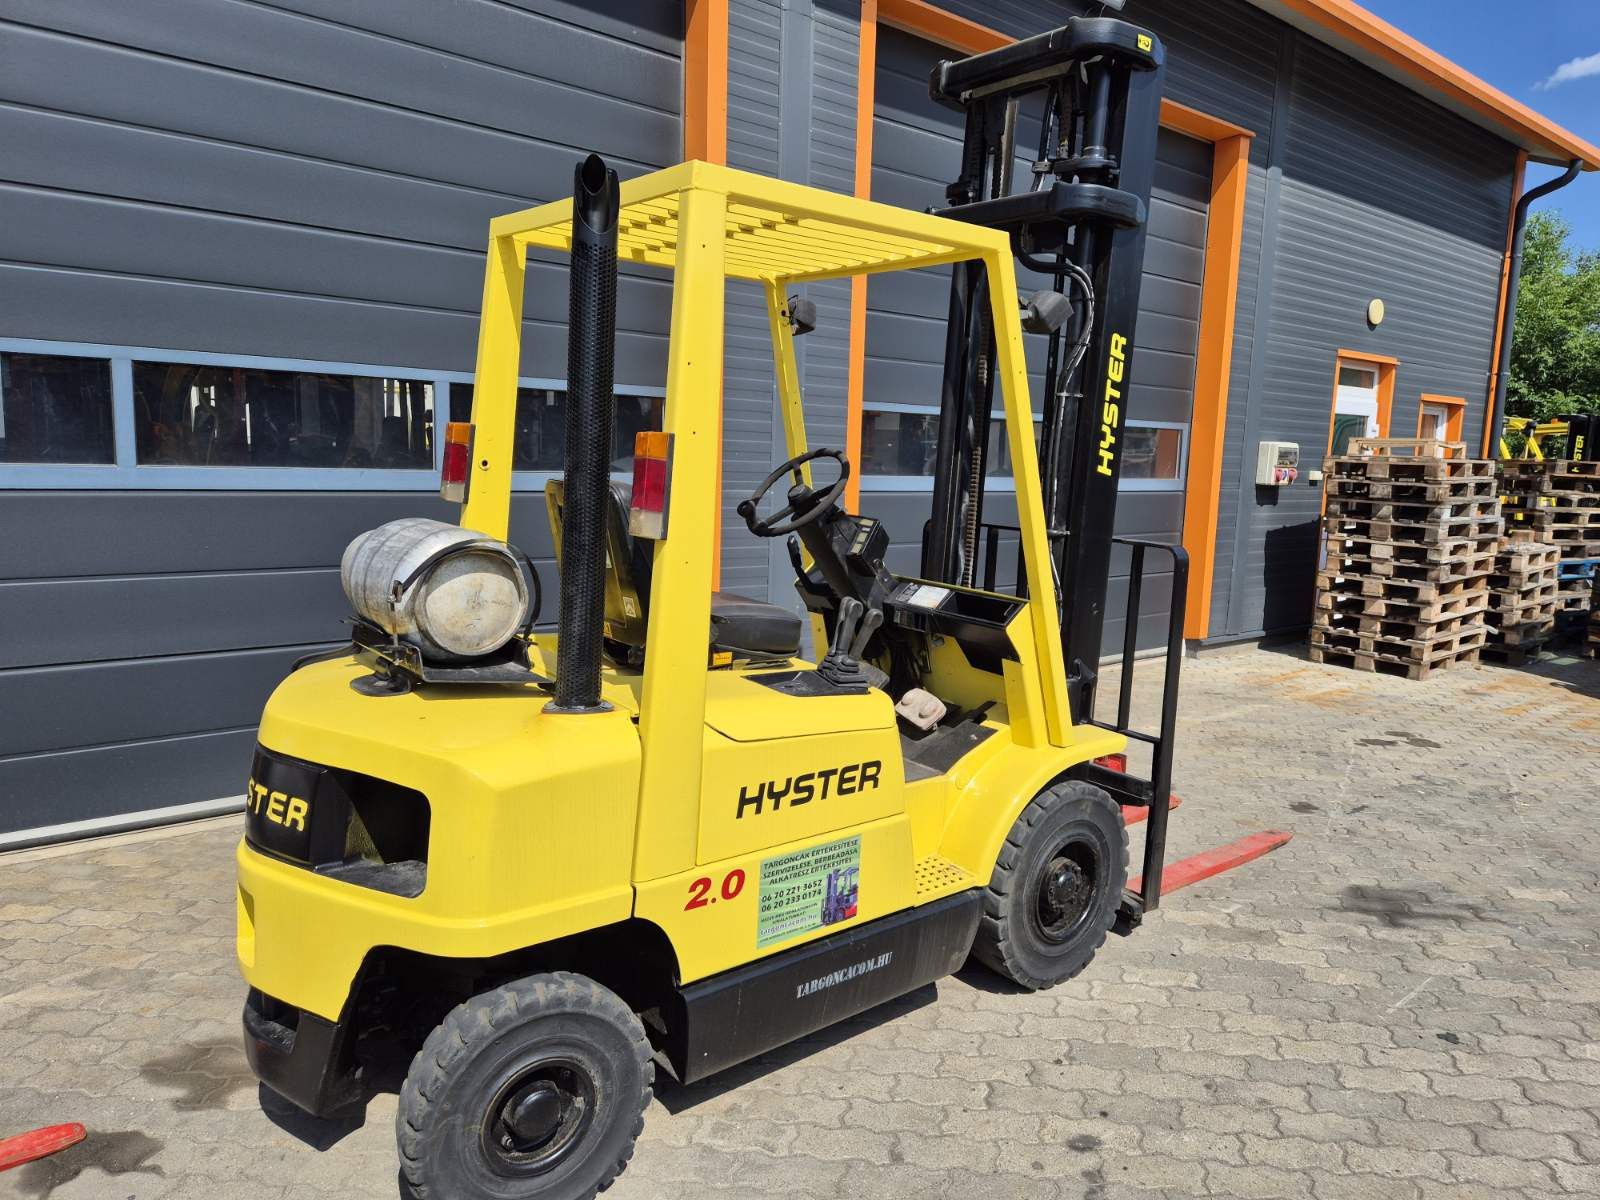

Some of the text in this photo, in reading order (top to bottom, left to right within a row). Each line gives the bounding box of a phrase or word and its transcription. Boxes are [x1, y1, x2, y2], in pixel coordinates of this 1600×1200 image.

[1096, 332, 1128, 477] HYSTER
[735, 759, 882, 819] HYSTER
[683, 868, 746, 911] 2.0
[761, 903, 772, 913] 06
[774, 900, 784, 909] 20
[785, 894, 801, 905] 233
[762, 894, 772, 903] 06
[786, 885, 800, 896] 221
[803, 879, 822, 891] 3652
[796, 951, 893, 1000] TARGONCACOM.HU
